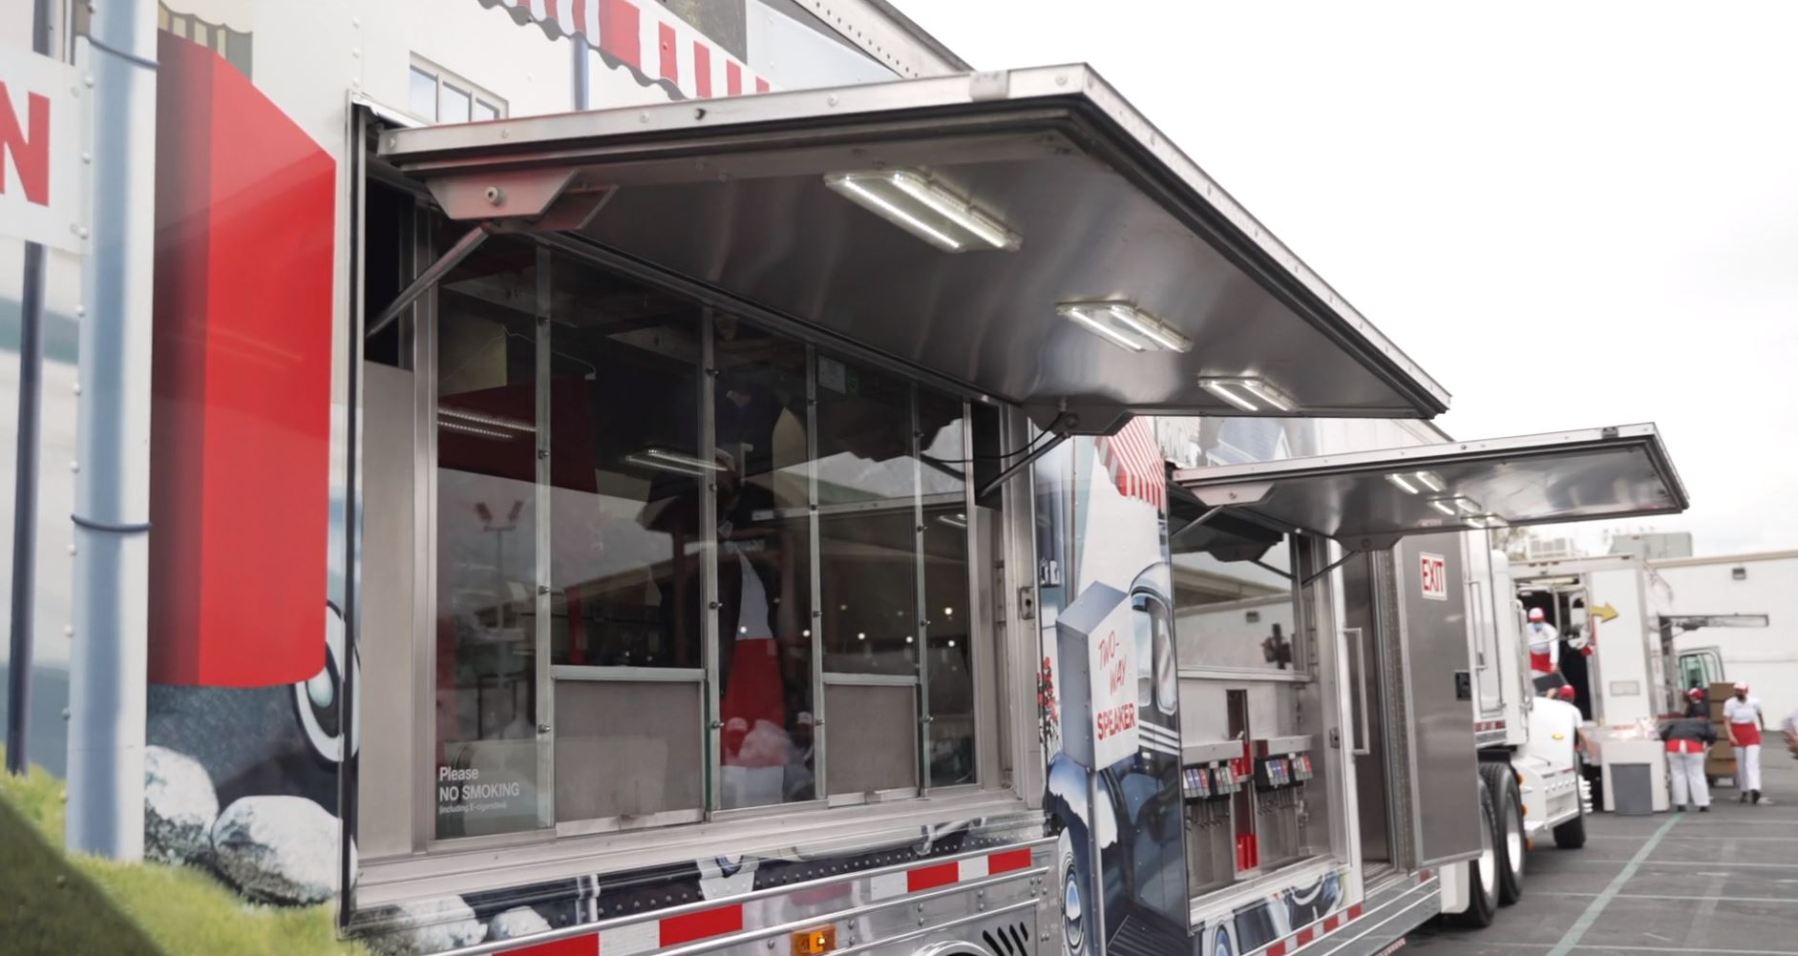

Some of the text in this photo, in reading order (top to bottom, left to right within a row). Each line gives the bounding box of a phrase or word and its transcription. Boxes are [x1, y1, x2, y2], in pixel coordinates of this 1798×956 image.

[1422, 558, 1445, 593] EXIT
[1098, 629, 1120, 671] TWO-
[1109, 654, 1127, 696] WAY
[1097, 702, 1136, 741] SPEAKER
[439, 766, 480, 782] Please
[439, 782, 520, 802] NO SMOKING
